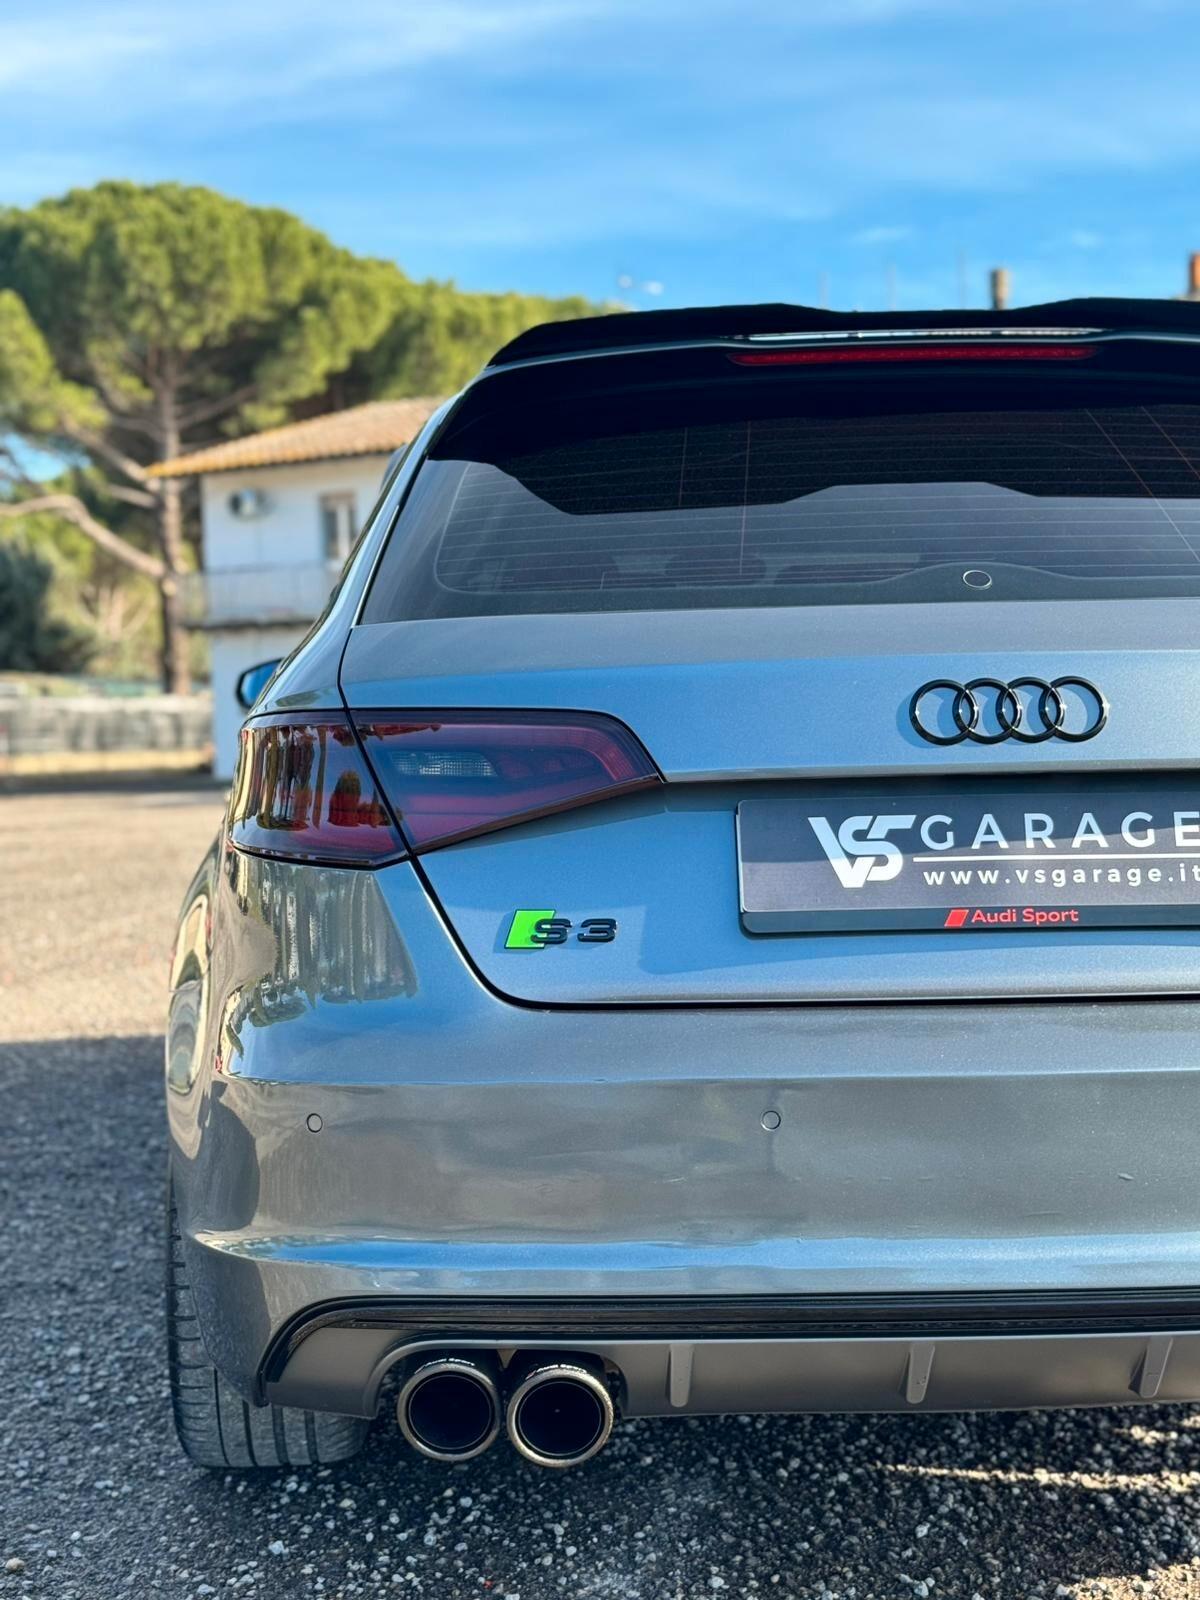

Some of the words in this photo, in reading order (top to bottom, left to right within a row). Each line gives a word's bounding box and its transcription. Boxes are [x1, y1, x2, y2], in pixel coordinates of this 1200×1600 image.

[807, 814, 917, 888] VS
[920, 811, 1200, 851] GARAGE
[923, 862, 1200, 887] www.vsgarage.it
[971, 909, 1017, 923] Audi
[1022, 908, 1079, 926] Sport
[530, 918, 617, 945] S3
